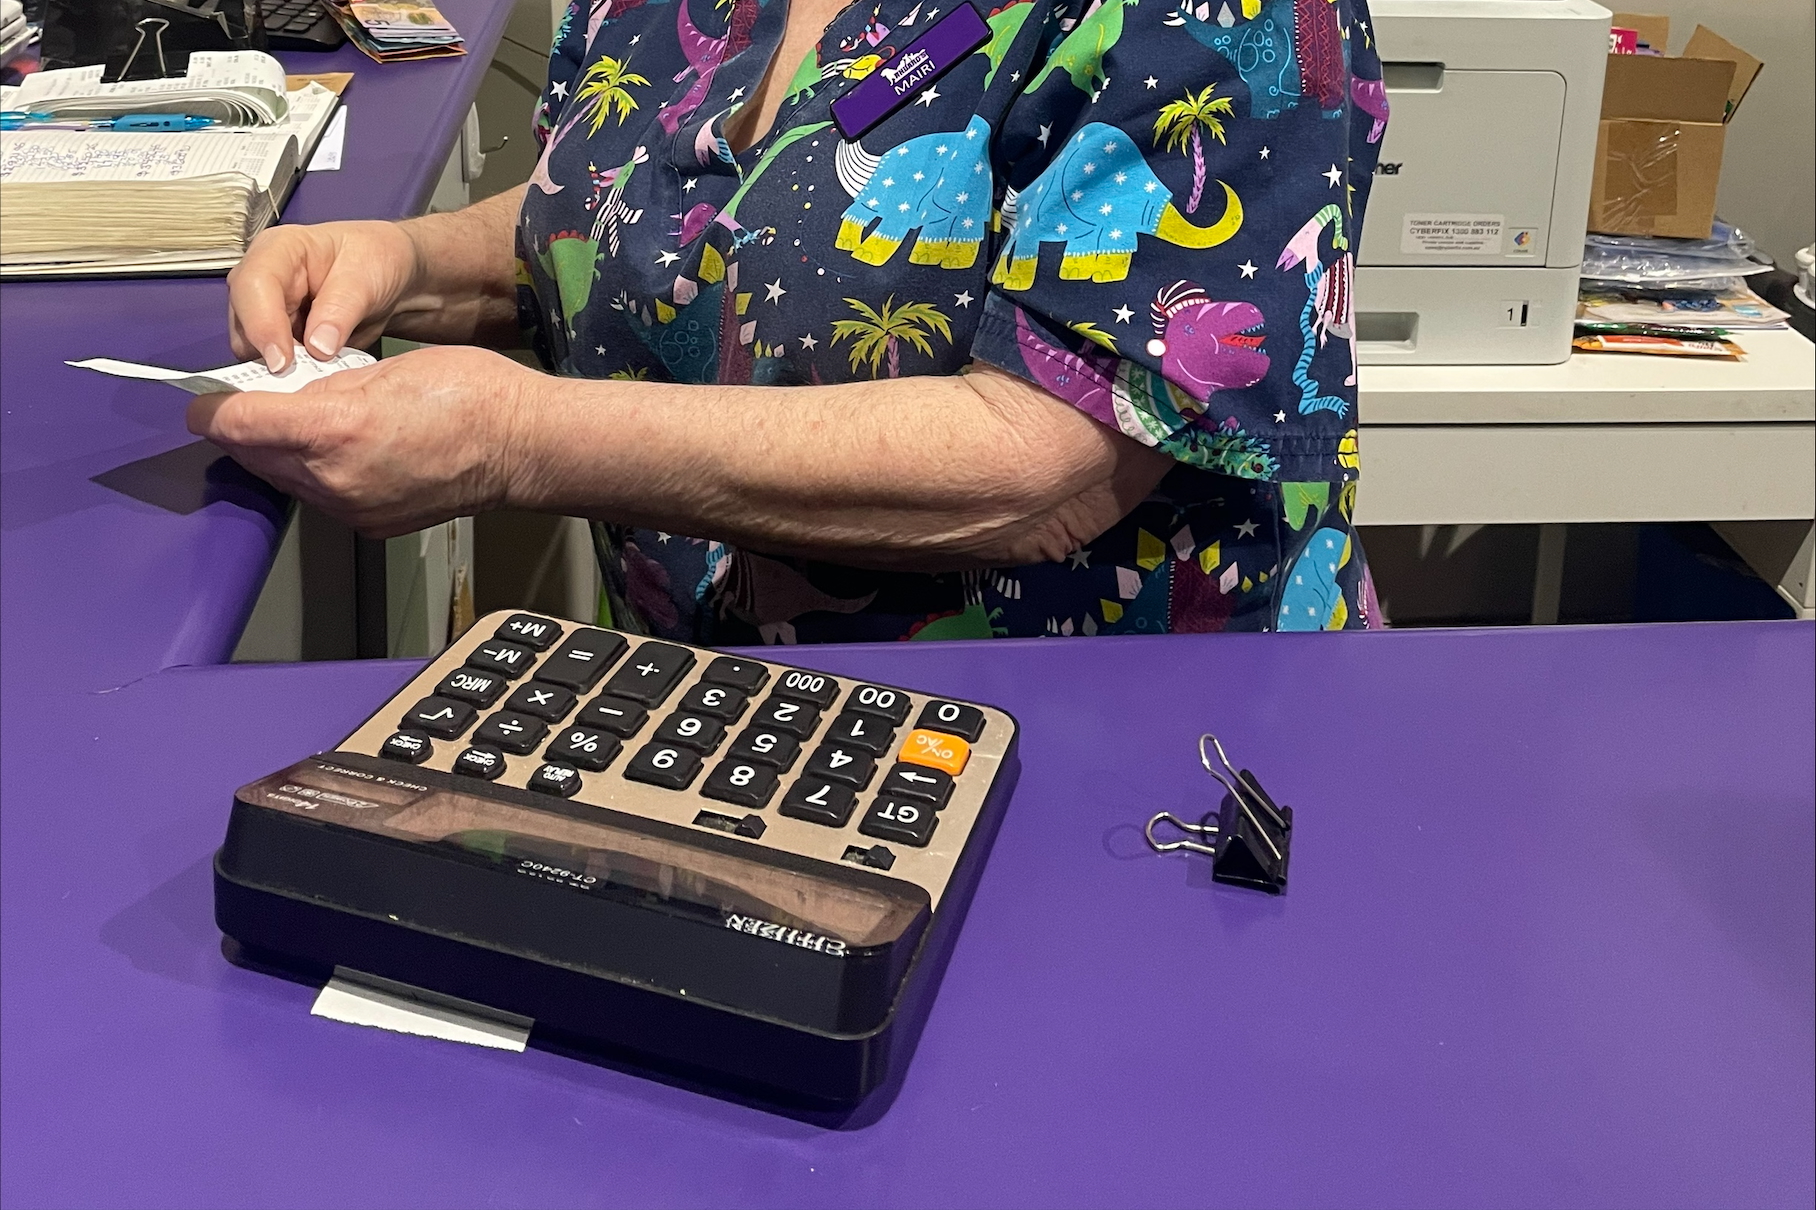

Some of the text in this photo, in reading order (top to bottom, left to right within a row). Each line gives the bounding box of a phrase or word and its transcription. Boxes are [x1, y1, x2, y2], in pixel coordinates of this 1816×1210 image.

[894, 60, 936, 96] MAIRI
[1507, 308, 1513, 321] 1
[509, 621, 547, 638] M+
[450, 674, 493, 693] MRC
[785, 672, 825, 693] 000
[702, 689, 726, 707] 3
[858, 688, 896, 708] 00
[773, 702, 800, 722] 2
[938, 704, 960, 721] 0
[676, 717, 702, 736] 6
[850, 719, 865, 737] 1
[390, 738, 423, 750] CHECK
[751, 734, 777, 754] 5
[916, 734, 954, 760] ON/AC
[462, 753, 495, 767] CHECK
[652, 749, 678, 769] 9
[829, 749, 853, 769] 4
[317, 764, 369, 780] CORRECT
[729, 765, 755, 786] 8
[389, 779, 428, 792] CHECK
[805, 784, 831, 806] 7
[877, 802, 920, 823] GT
[520, 860, 597, 885] CT-9240C
[724, 913, 847, 957] CITIZEN
